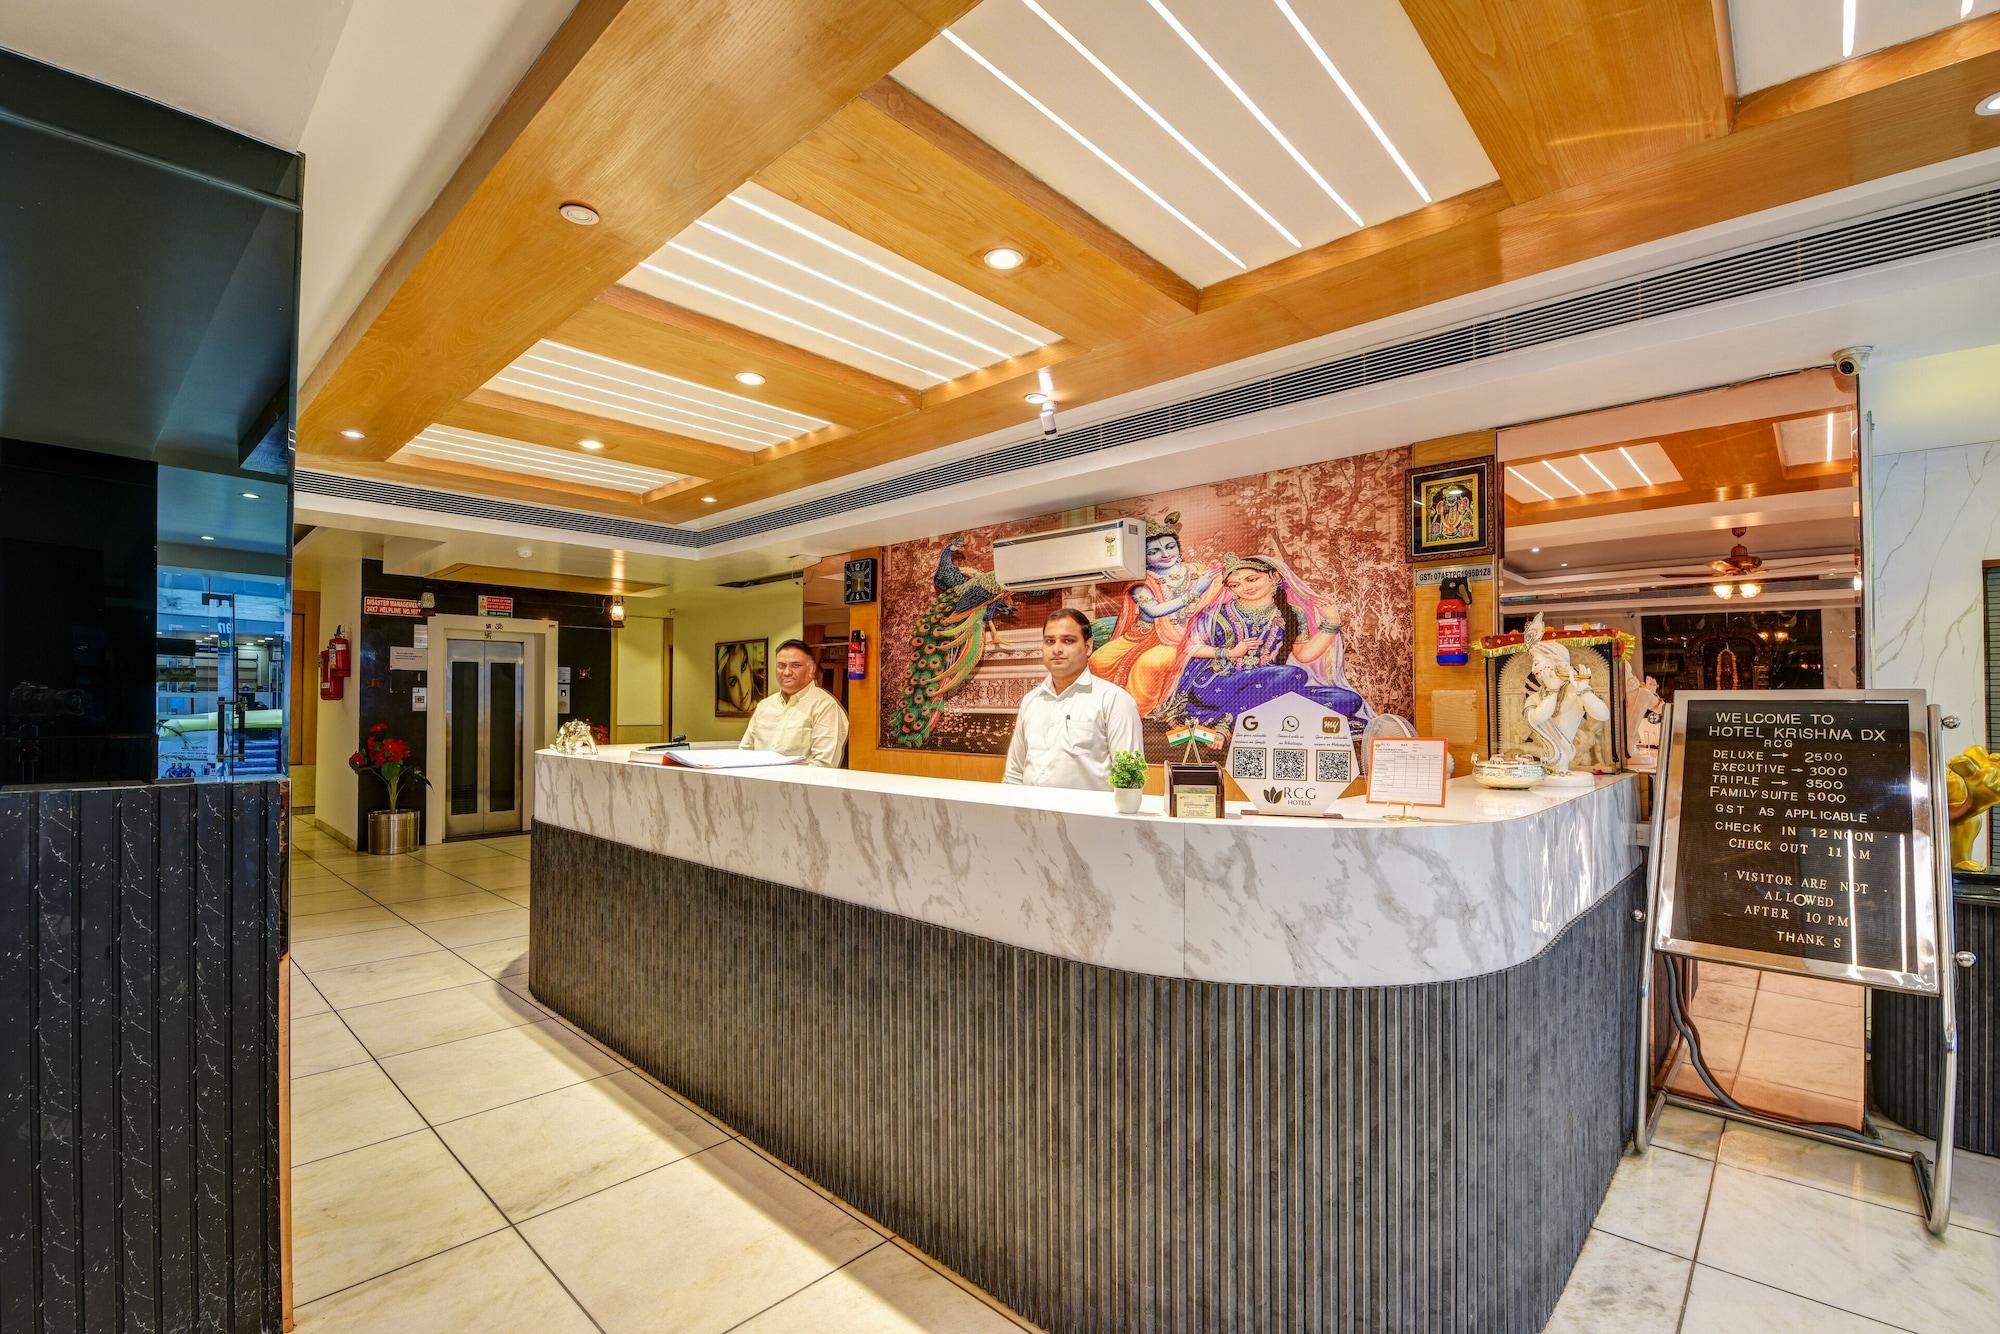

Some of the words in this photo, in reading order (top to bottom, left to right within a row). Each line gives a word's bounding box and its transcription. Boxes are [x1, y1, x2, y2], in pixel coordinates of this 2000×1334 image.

[1419, 573, 1433, 582] GST:
[1716, 712, 1801, 724] WELCOME
[1810, 714, 1834, 725] TO
[1708, 726, 1764, 738] HOTEL
[1774, 727, 1853, 740] KRISHNA
[1860, 728, 1886, 742] DX
[1764, 739, 1793, 748] RCG
[1713, 749, 1764, 760] DELUXE
[1804, 752, 1842, 763] 2500
[1712, 762, 1786, 774] EXECUTIVE
[1809, 766, 1848, 776] 3000
[1712, 774, 1760, 786] TRIPLE
[1806, 779, 1843, 790] 3500
[1284, 786, 1316, 800] RCG
[1710, 786, 1758, 798] FAMILY
[1761, 790, 1798, 801] SUITE
[1808, 792, 1846, 804] 5000
[1715, 804, 1744, 815] GST
[1759, 807, 1775, 816] AS
[1785, 808, 1868, 824] APPLICABLE
[1715, 822, 1762, 833] CHECK
[1782, 826, 1796, 836] IN
[1811, 828, 1828, 838] 12
[1728, 838, 1772, 851] CHECK
[1780, 842, 1808, 855] OUT
[1828, 846, 1842, 858] 11
[1736, 870, 1792, 886] VISITOR
[1801, 878, 1828, 890] ARE
[1764, 891, 1834, 908] ALLOWED
[1744, 905, 1790, 920] AFTER
[1806, 912, 1821, 924] 10
[1828, 915, 1848, 928] PM
[1777, 931, 1824, 946] THANK
